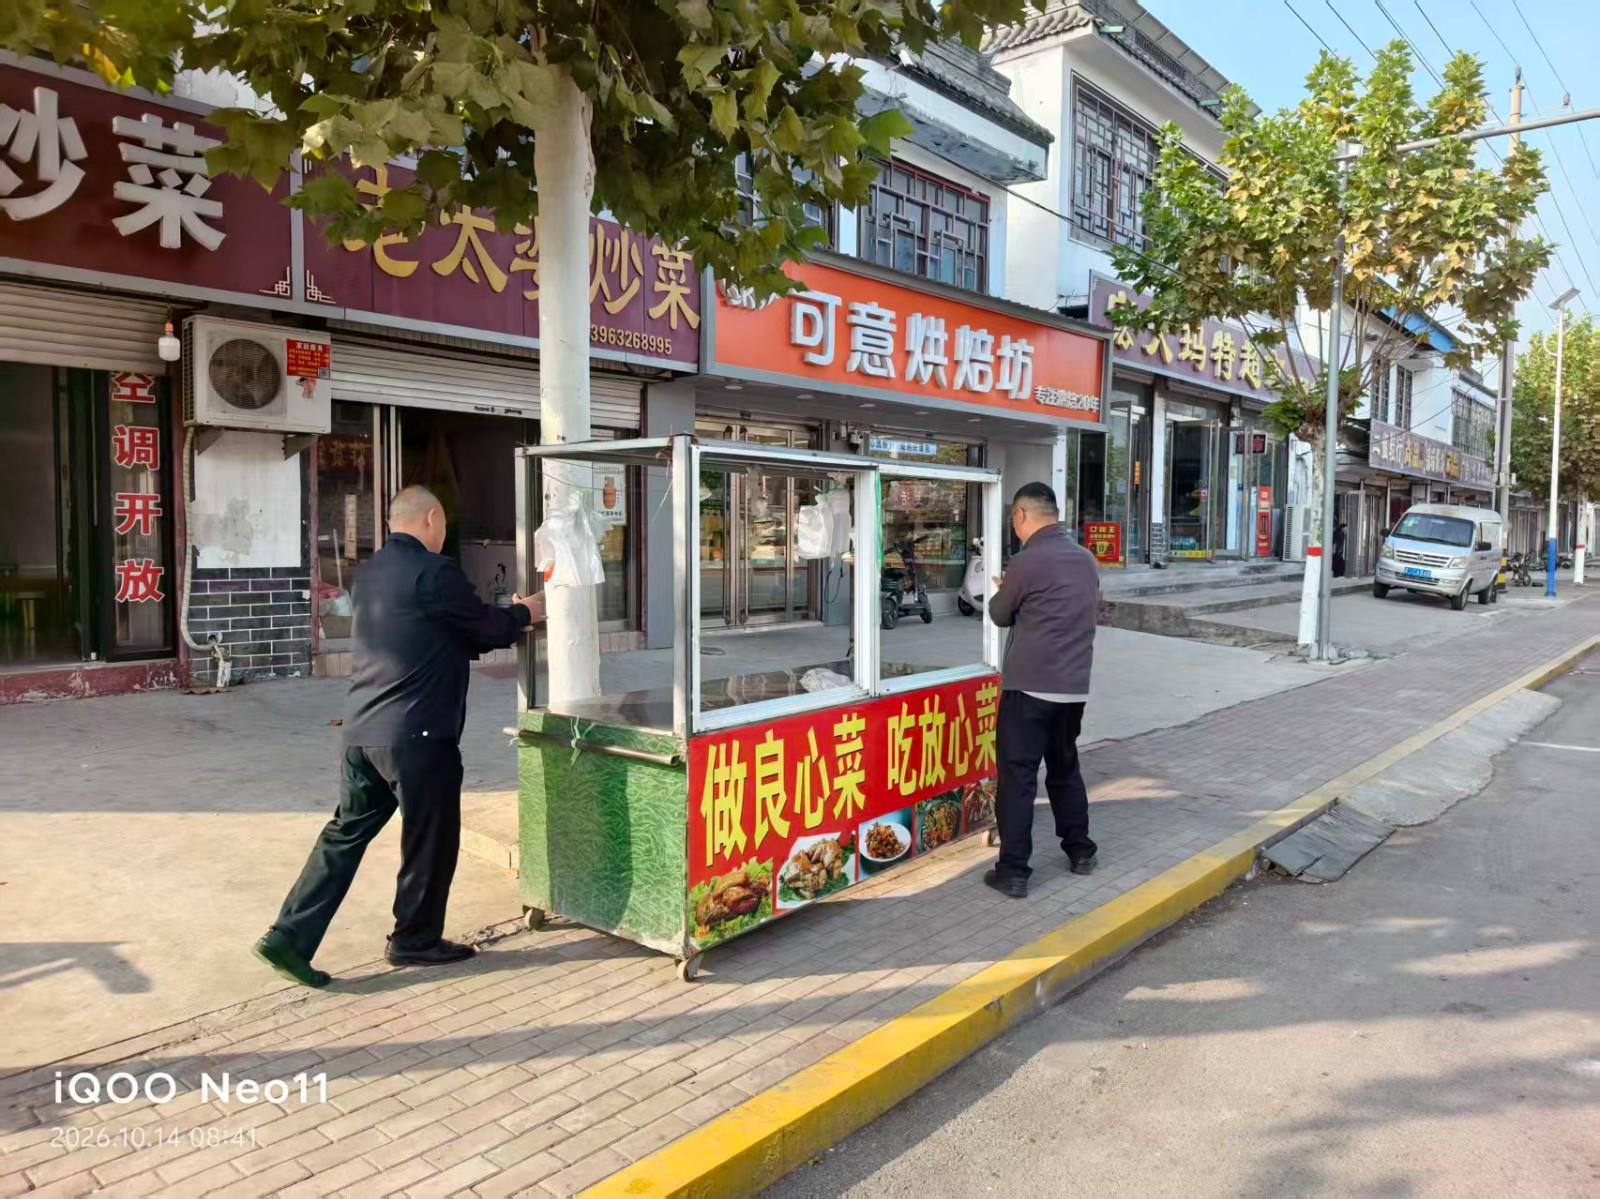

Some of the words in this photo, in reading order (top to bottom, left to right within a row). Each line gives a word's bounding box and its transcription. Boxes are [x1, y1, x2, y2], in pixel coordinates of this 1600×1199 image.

[0, 86, 227, 251] 炒菜
[591, 323, 673, 355] 3963268995
[787, 287, 1035, 400] 可意烘焙坊
[112, 371, 165, 603] 空调开放
[700, 712, 866, 867] 做良心菜
[887, 682, 998, 796] 吃放心菜
